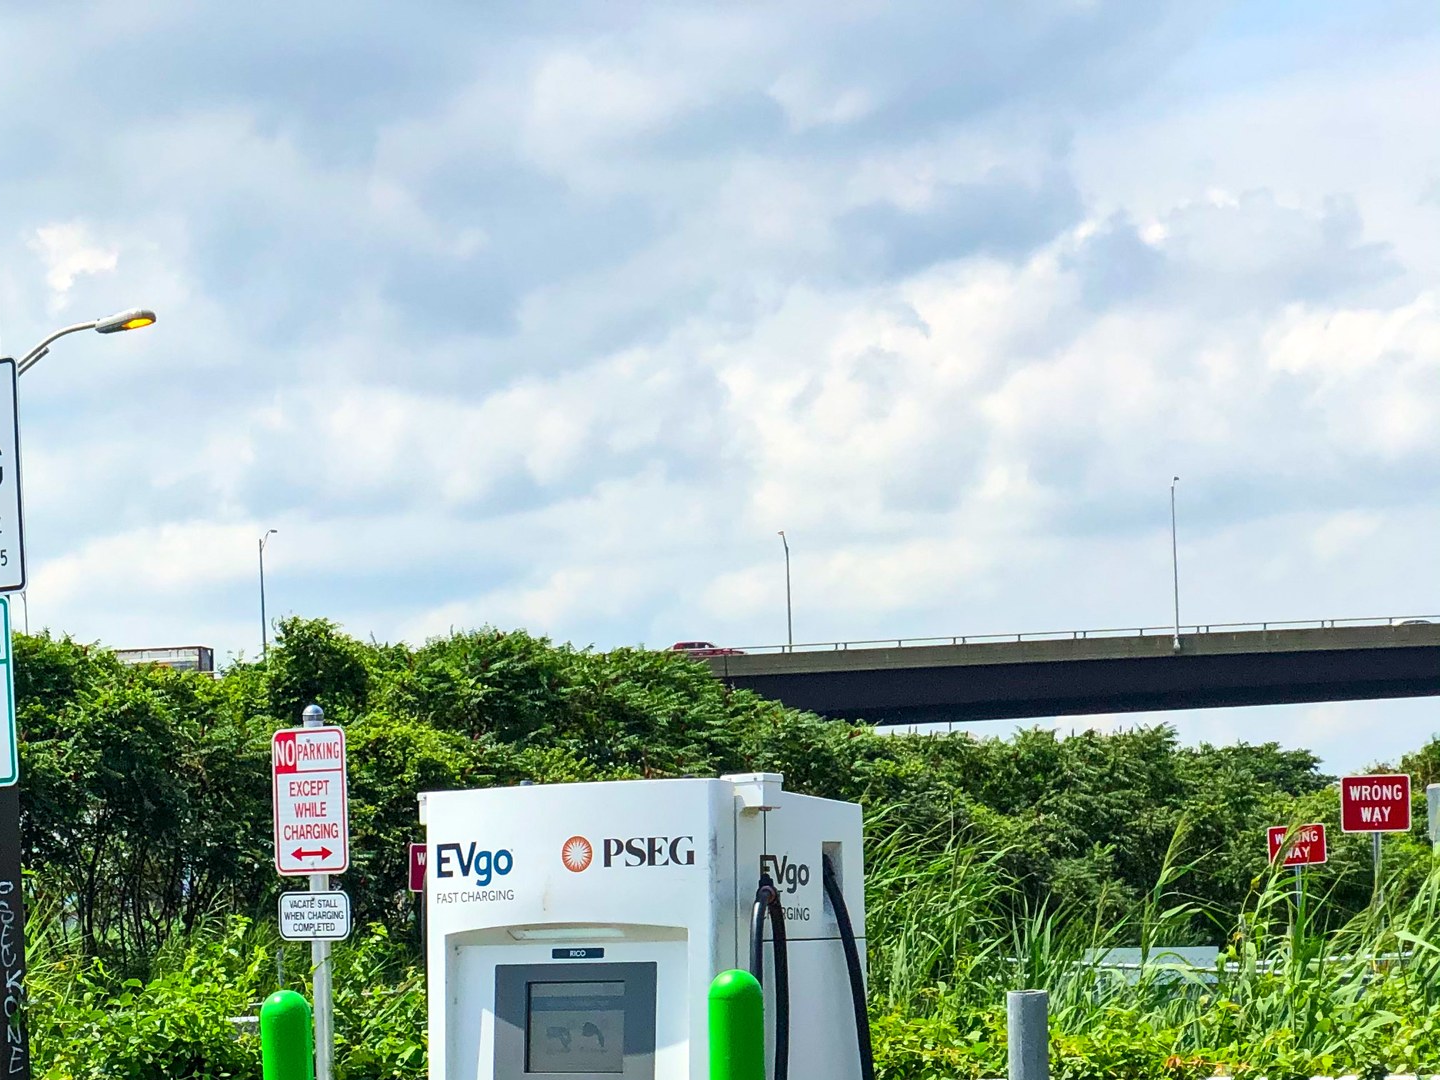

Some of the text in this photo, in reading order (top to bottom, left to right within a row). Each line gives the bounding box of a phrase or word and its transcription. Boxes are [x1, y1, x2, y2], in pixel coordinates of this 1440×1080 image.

[275, 739, 340, 767] NO PARKING
[289, 780, 329, 797] EXCEPT
[1349, 784, 1403, 801] WRONG
[294, 801, 327, 818] WHILE
[1360, 806, 1391, 823] WAY
[283, 822, 339, 841] CHARGING
[1274, 830, 1319, 845] WNG
[603, 836, 695, 868] PSEG
[436, 841, 514, 887] EVgo
[759, 854, 810, 894] EVgo
[289, 899, 338, 909] VACATE STALL
[436, 889, 515, 904] FAST CHARGING
[284, 911, 344, 920] WHEN CHARGING
[293, 922, 336, 932] COMPLETED
